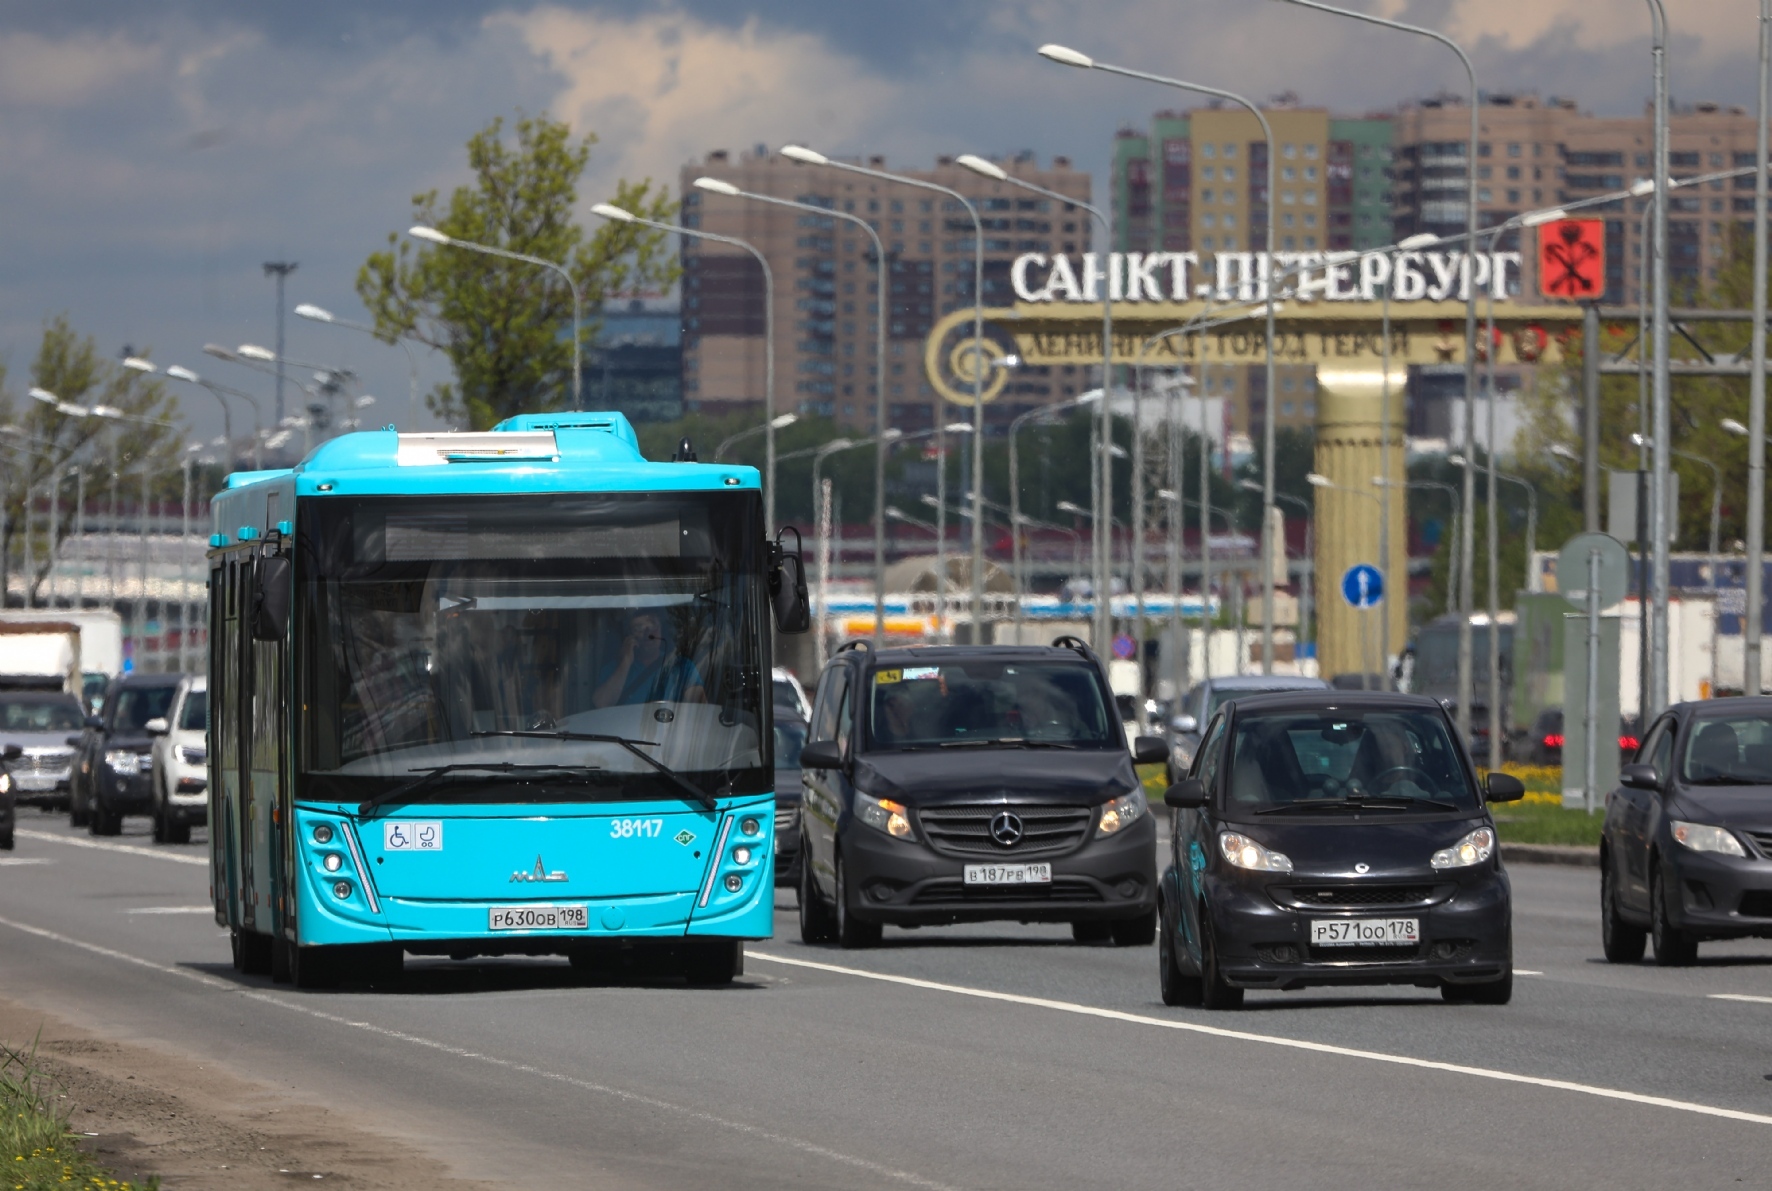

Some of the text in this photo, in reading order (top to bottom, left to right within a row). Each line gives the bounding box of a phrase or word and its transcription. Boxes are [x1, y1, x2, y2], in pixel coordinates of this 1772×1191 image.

[1010, 251, 1523, 302] САНКТ-ПЕТЕРБУРГ
[609, 818, 663, 839] 38117
[494, 909, 583, 926] Р630ОВ 198
[1317, 921, 1414, 940] Р571ОО 178
